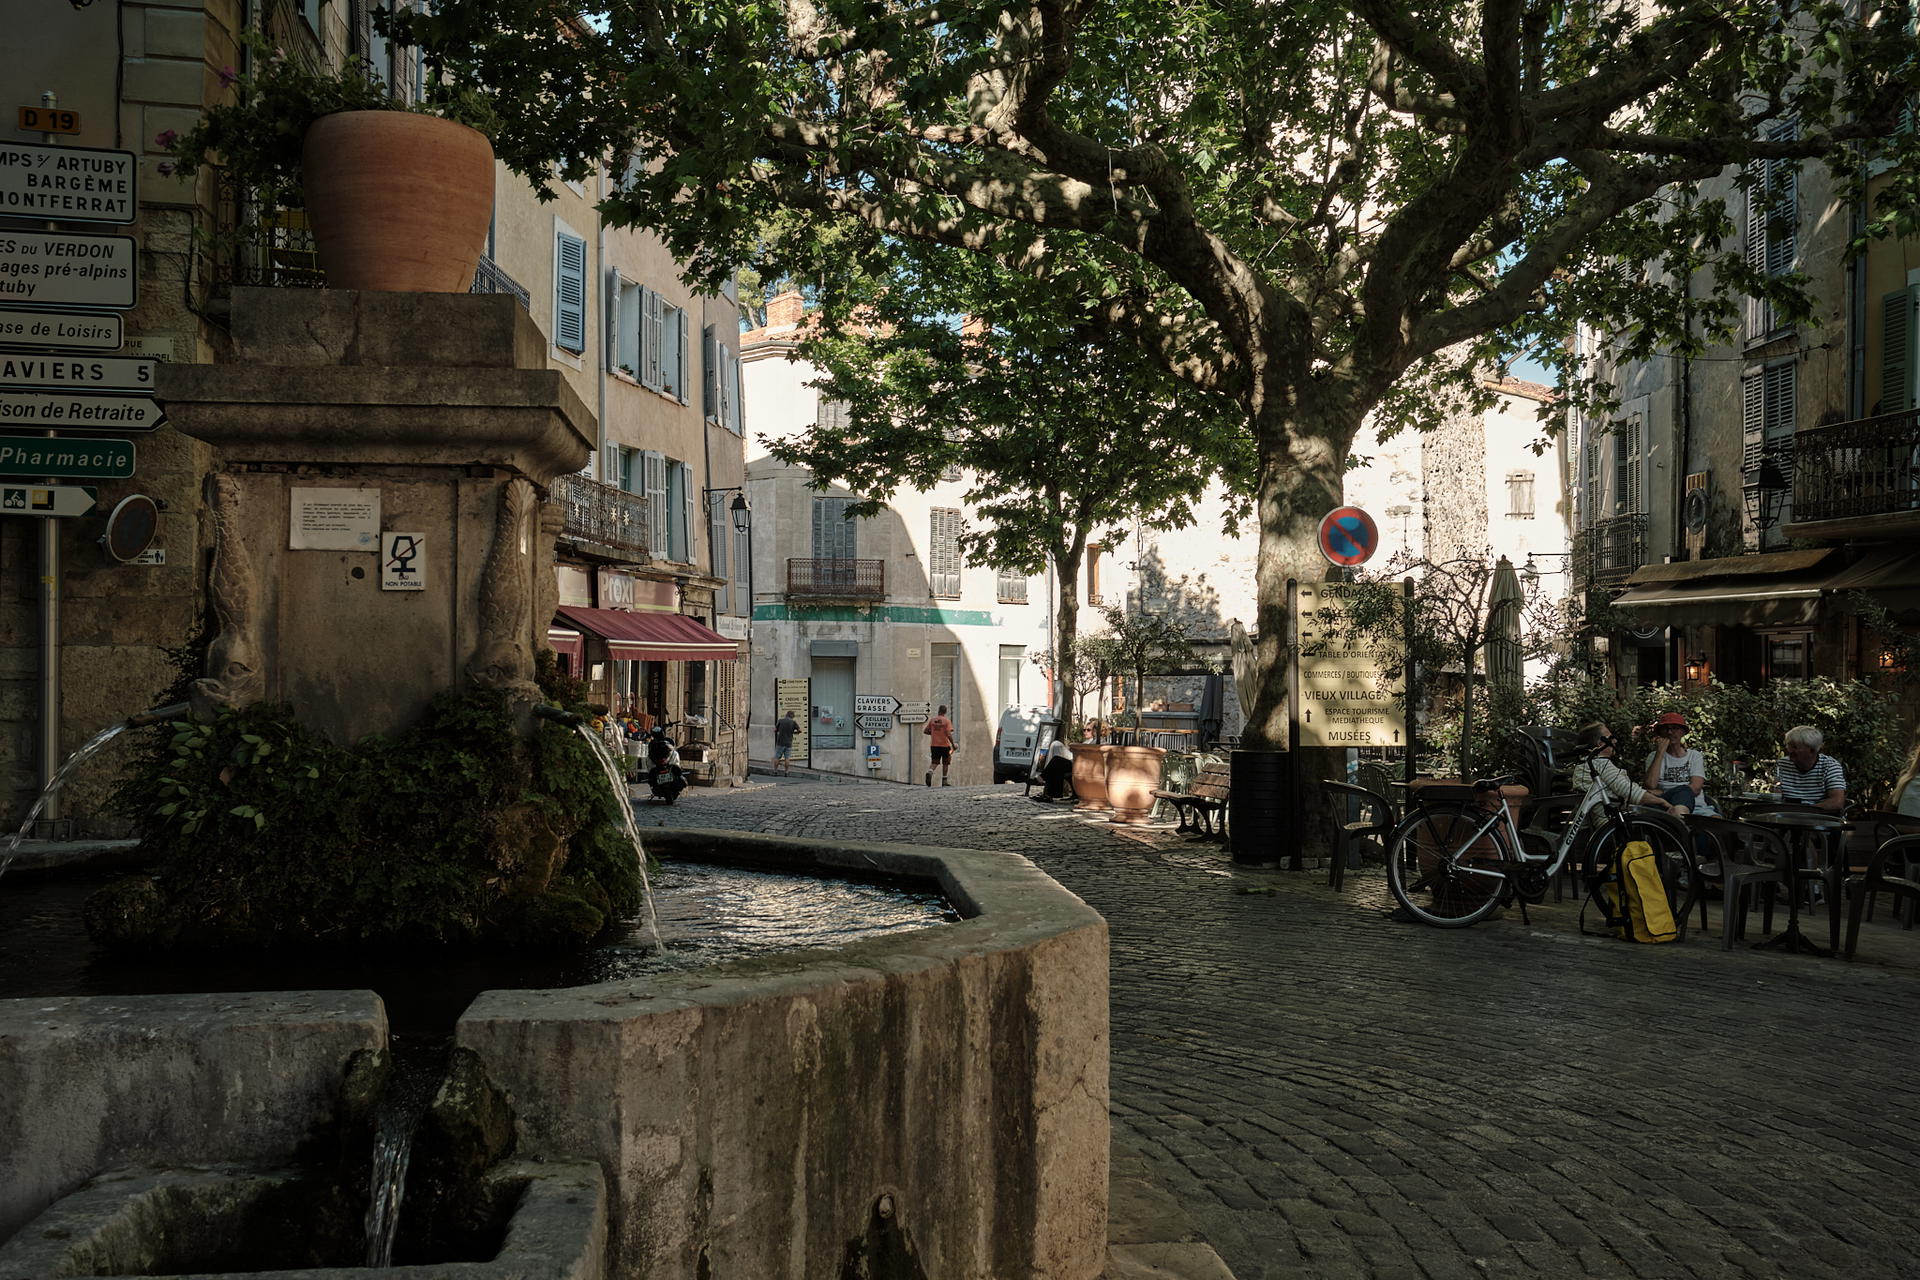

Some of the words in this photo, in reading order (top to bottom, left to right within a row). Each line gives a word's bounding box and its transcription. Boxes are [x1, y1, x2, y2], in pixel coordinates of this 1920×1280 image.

[24, 109, 38, 127] D
[48, 111, 74, 130] 19
[56, 156, 126, 174] ARTUBY
[27, 173, 127, 194] BARGÈME
[0, 191, 127, 213] ONTFERRAT
[21, 245, 38, 255] DU
[44, 241, 114, 259] VERDON
[0, 262, 40, 277] ages
[44, 262, 128, 281] pré-alpins
[31, 321, 51, 336] de
[57, 323, 113, 339] Loisirs
[2, 360, 104, 381] AVIERS
[137, 365, 150, 382] 5
[40, 401, 64, 418] de
[68, 402, 146, 421] Retraite
[0, 446, 127, 468] Pharmacie
[1320, 587, 1399, 598] GENDAE
[1318, 651, 1342, 659] TABLE
[1342, 650, 1392, 659] D'ORIENTA
[1303, 670, 1342, 679] COMMERCES
[857, 697, 891, 705] CLAVIERS
[1304, 690, 1337, 701] VIEUX
[1339, 690, 1382, 701] VILLAGE
[1325, 708, 1350, 716] ESPACE
[1352, 708, 1390, 716] TOURISME
[1328, 728, 1371, 741] MUSÉES
[1565, 811, 1584, 846] GITANE
